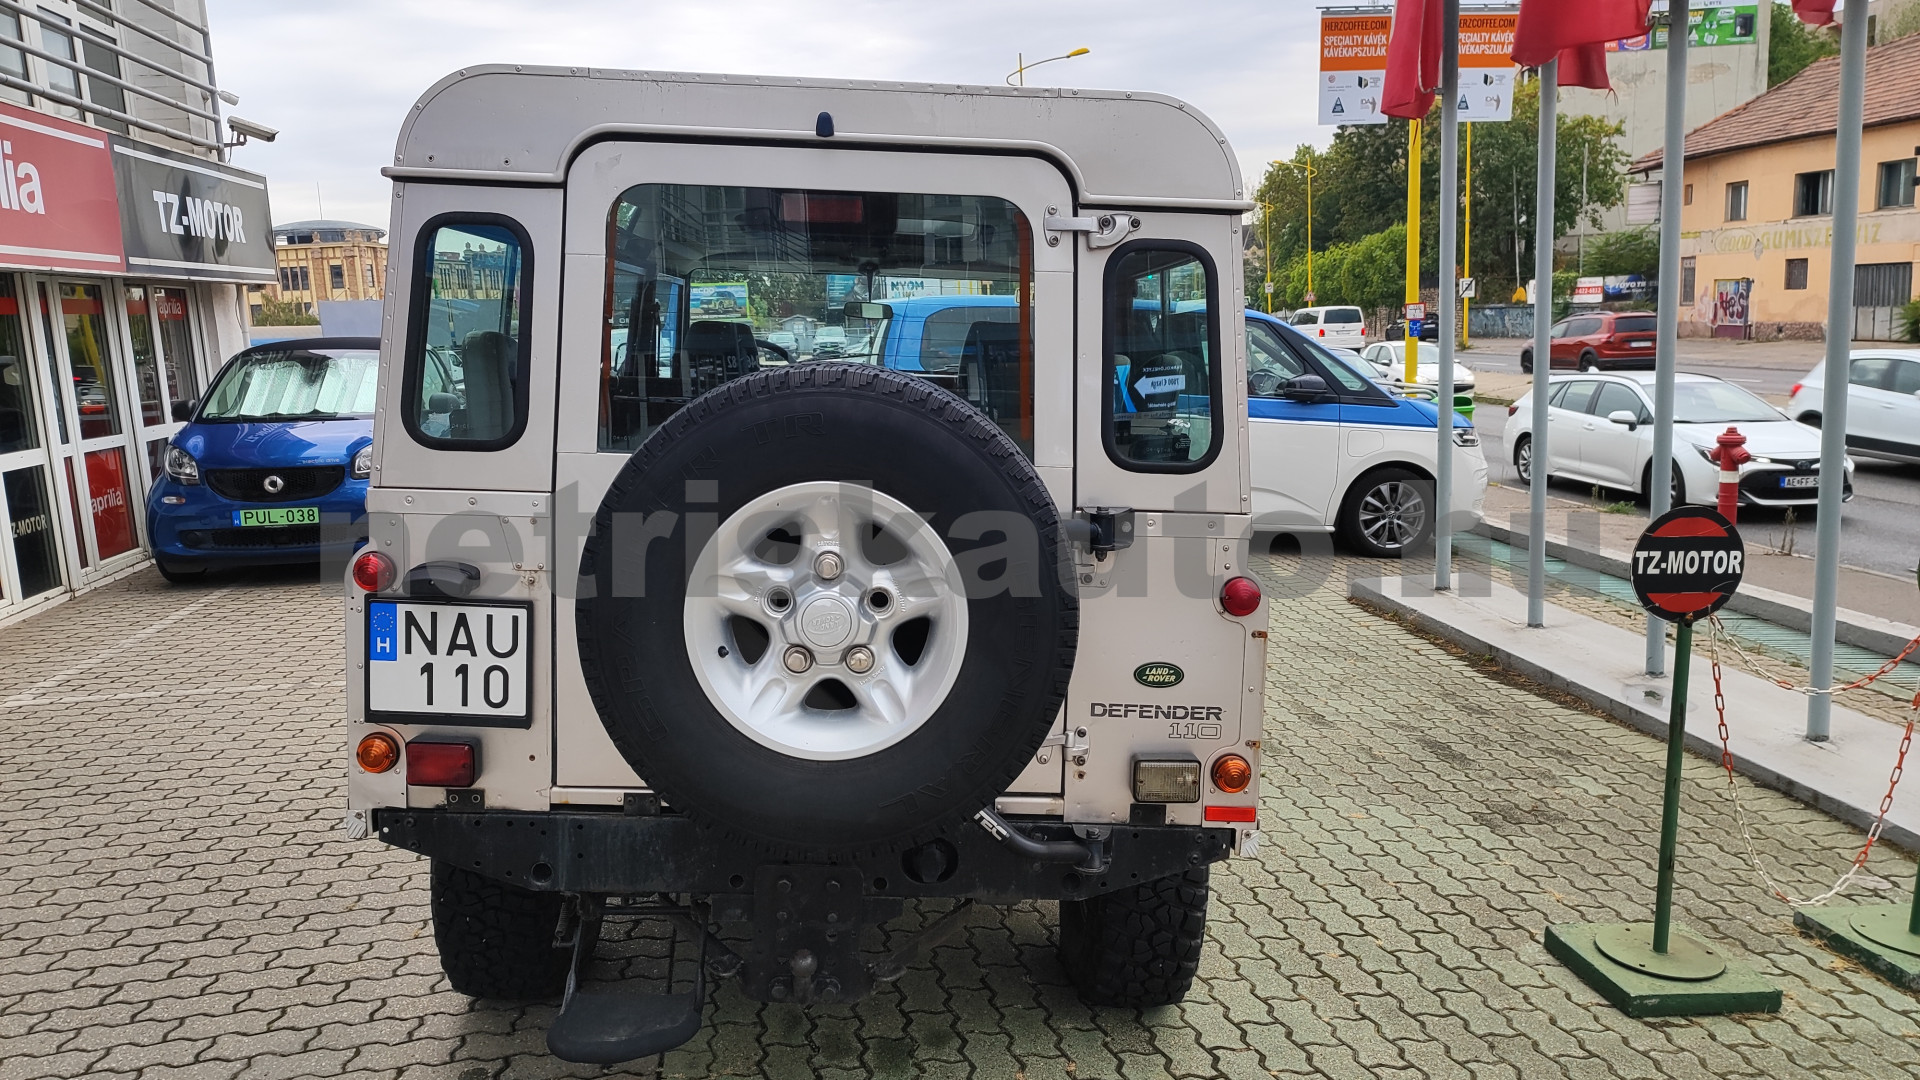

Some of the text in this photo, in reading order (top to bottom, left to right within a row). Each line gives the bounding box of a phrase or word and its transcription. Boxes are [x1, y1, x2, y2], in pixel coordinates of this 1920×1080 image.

[1324, 20, 1388, 32] HERZCOFFEE.COM
[1458, 18, 1516, 29] ERZCOFFEE.COM
[1323, 31, 1387, 46] SPECIALTY KÁVÉK
[1458, 30, 1515, 44] PECIALTY KÁVÉK
[1323, 45, 1387, 58] KÁVÉKAPSZULÁK
[1458, 43, 1513, 55] ÁVÉKAPSZULÁK
[153, 189, 247, 243] TZ-MOTOR
[890, 280, 925, 292] NYOM
[1615, 281, 1636, 289] TOYO
[159, 299, 182, 318] aprilia
[91, 487, 123, 517] aprilia
[243, 508, 316, 525] PUL-038
[10, 514, 48, 539] Z-MOTOR
[1635, 550, 1743, 575] TZ-MOTOR
[376, 609, 519, 659] H NAU
[420, 661, 510, 709] 110
[1090, 702, 1224, 721] DEFENDER
[1168, 722, 1223, 740] 110
